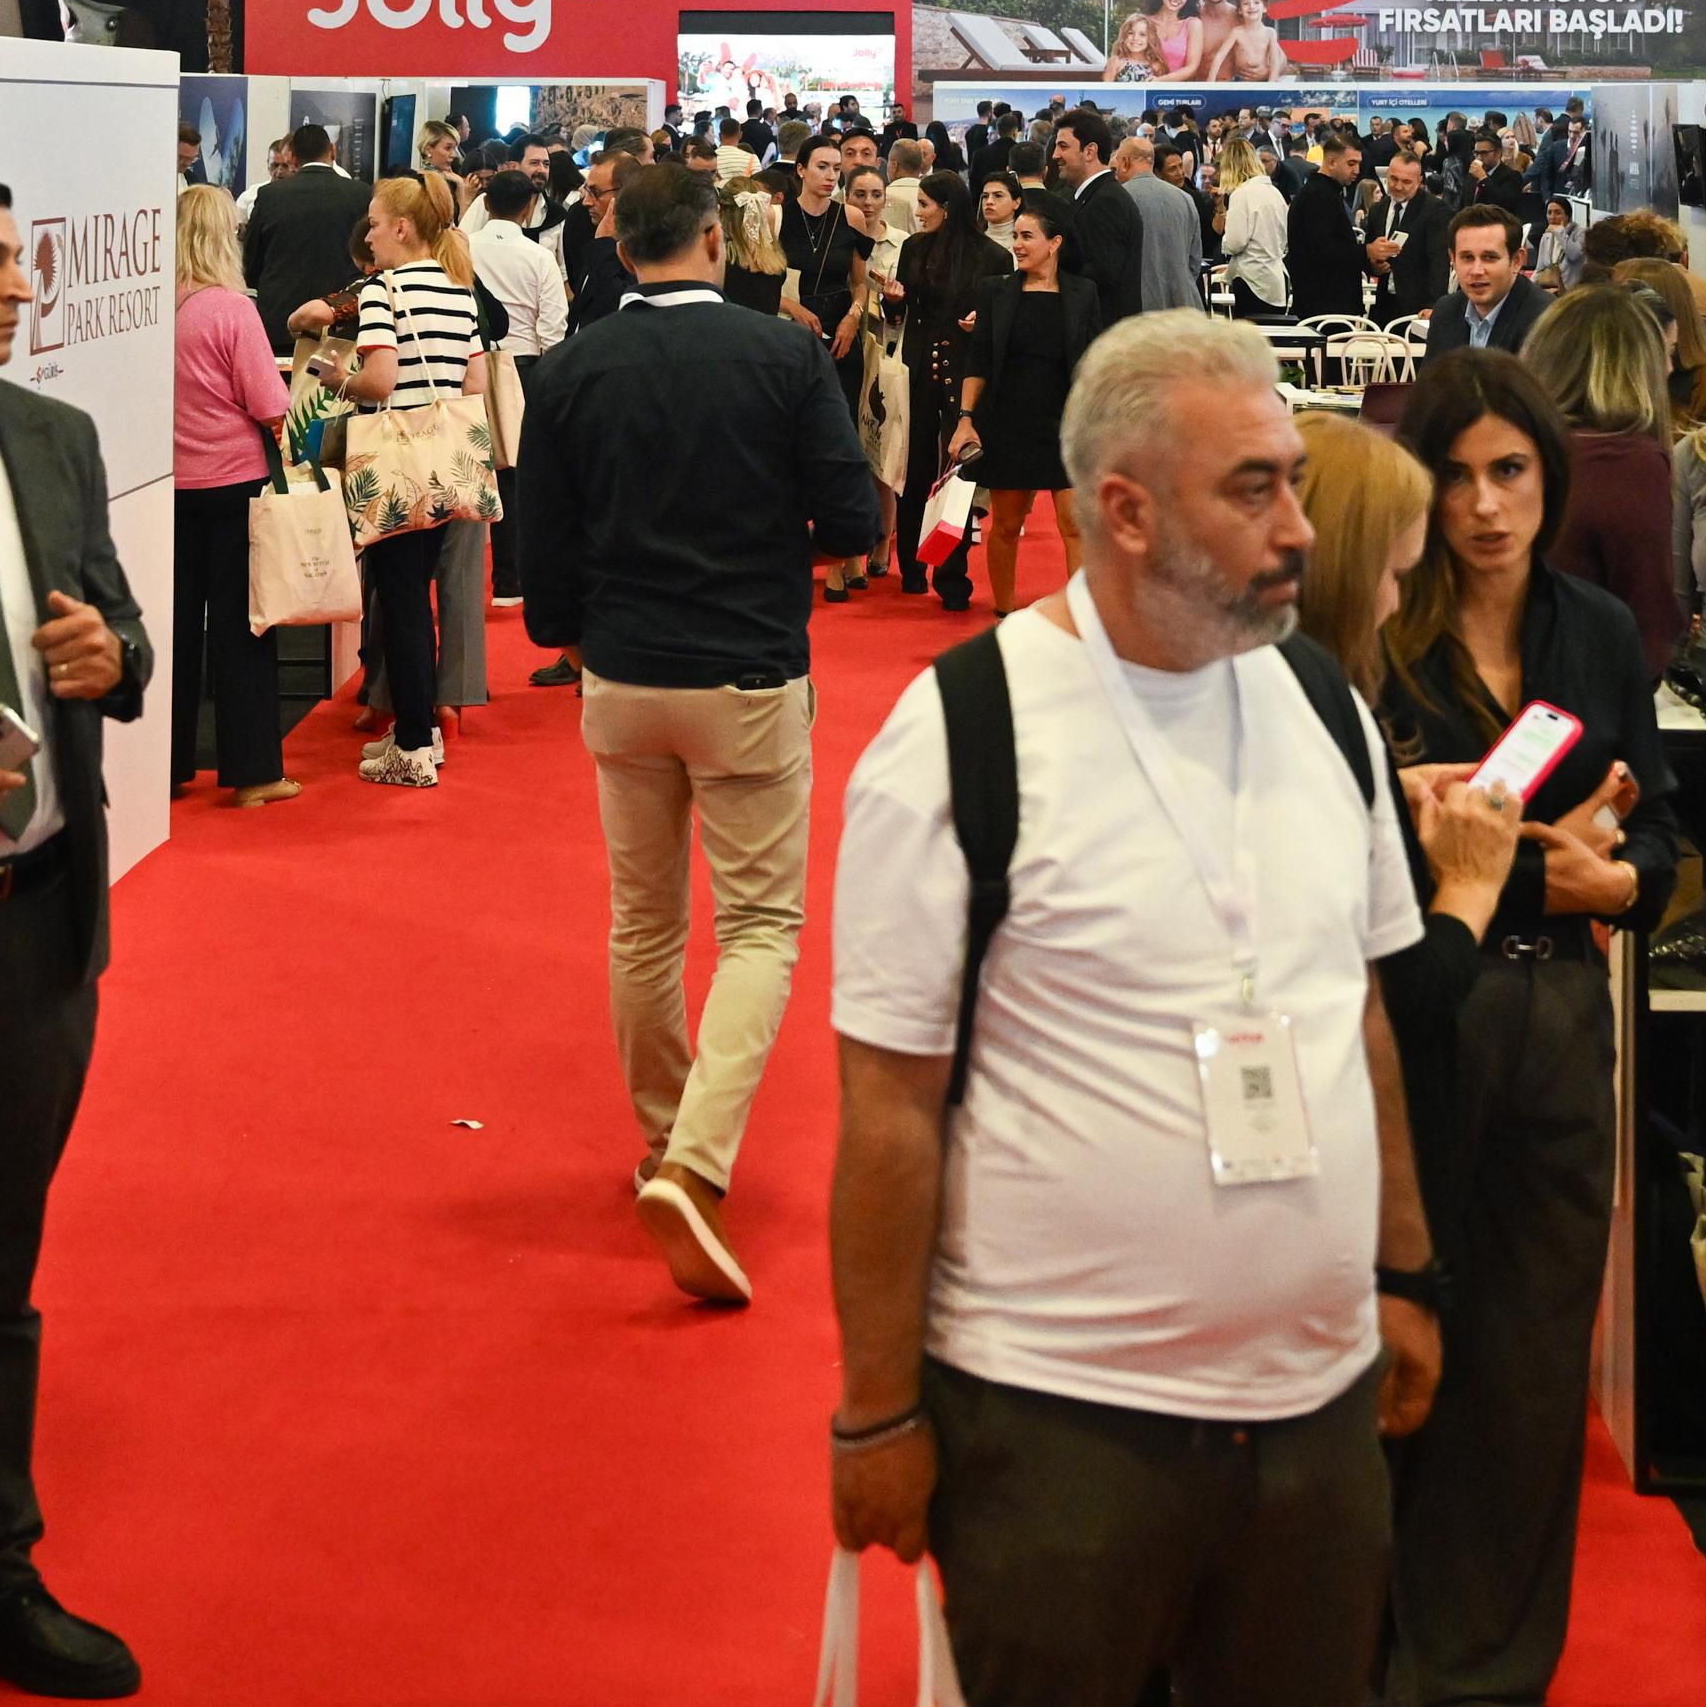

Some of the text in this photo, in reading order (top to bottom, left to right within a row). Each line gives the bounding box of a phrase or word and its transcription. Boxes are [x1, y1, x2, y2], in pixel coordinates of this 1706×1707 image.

[1379, 8, 1684, 40] FIRSATLARI BAŞLADI!
[1371, 98, 1388, 106] YURT
[67, 208, 161, 288] MIRAGE
[67, 286, 161, 346] PARK RESORT
